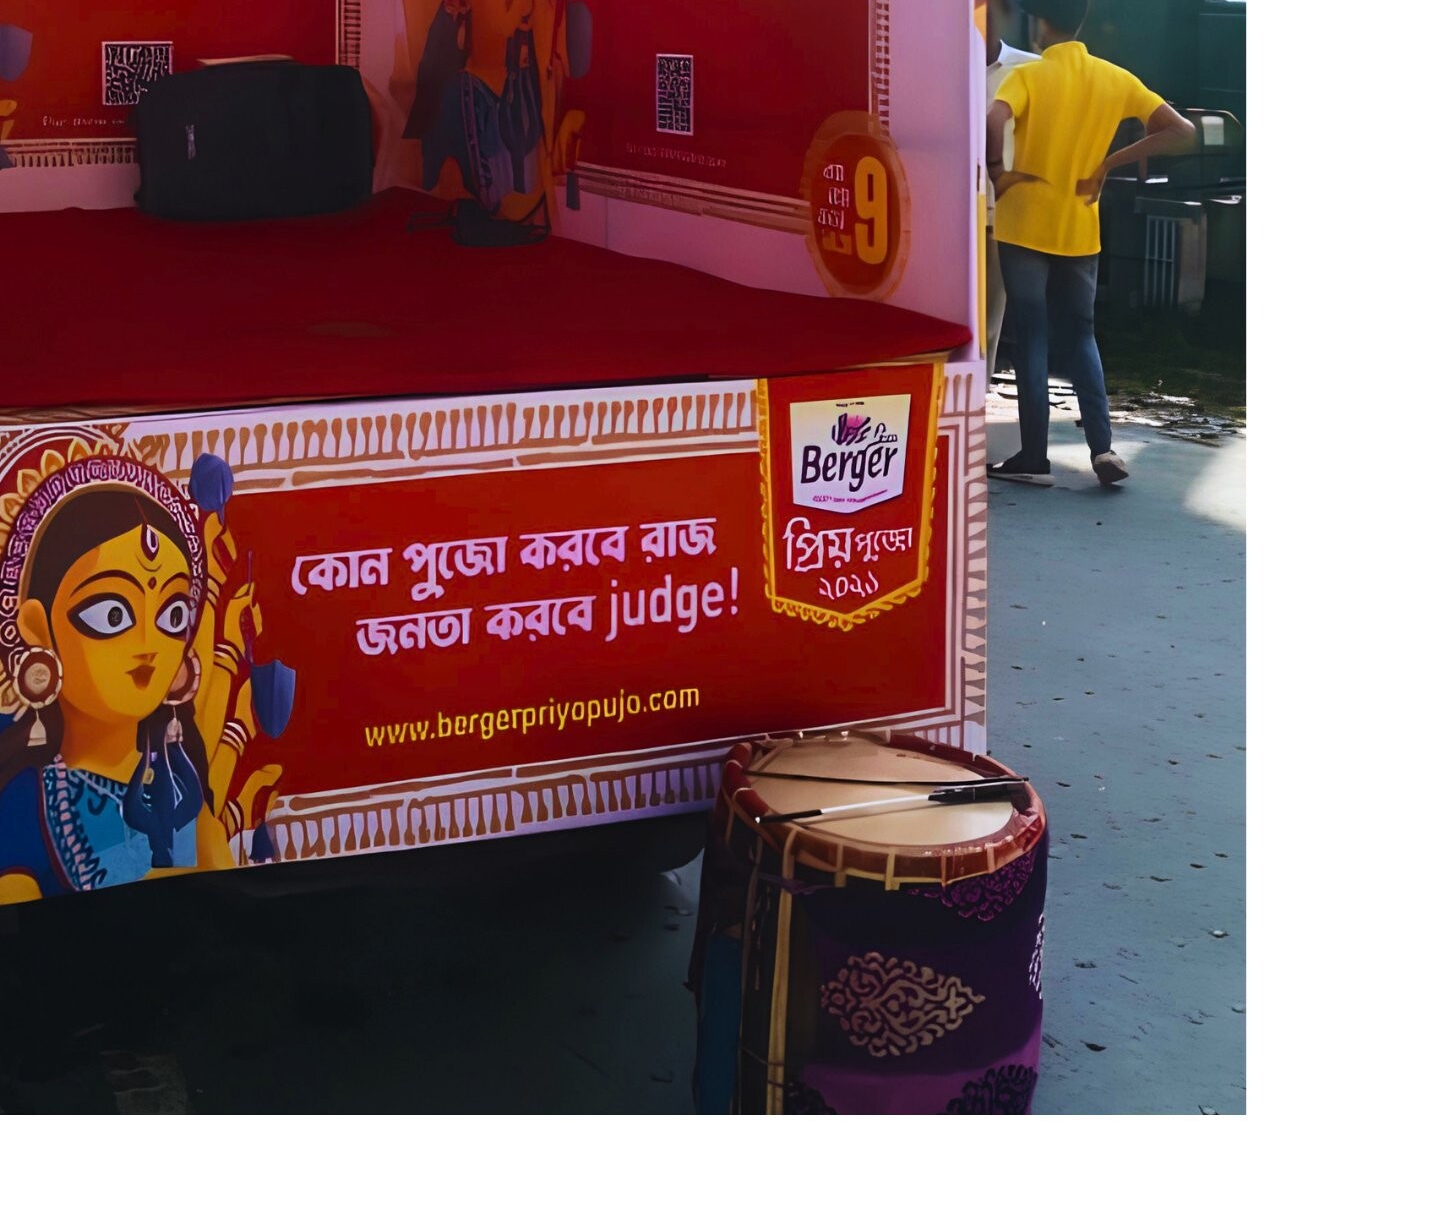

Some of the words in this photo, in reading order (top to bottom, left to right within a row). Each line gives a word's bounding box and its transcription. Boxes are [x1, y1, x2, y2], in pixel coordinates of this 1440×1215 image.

[854, 156, 888, 265] 9
[800, 441, 899, 493] Berger
[291, 548, 393, 596] কোন
[403, 536, 509, 602] পুজো
[519, 525, 629, 573] করবে
[640, 517, 717, 564] রাজ
[782, 516, 855, 573] প্রিয়
[355, 607, 473, 656] জনতা
[484, 595, 597, 642] করবে
[605, 566, 740, 642] judge!
[364, 687, 701, 747] www.bergerpriyopujo.com
